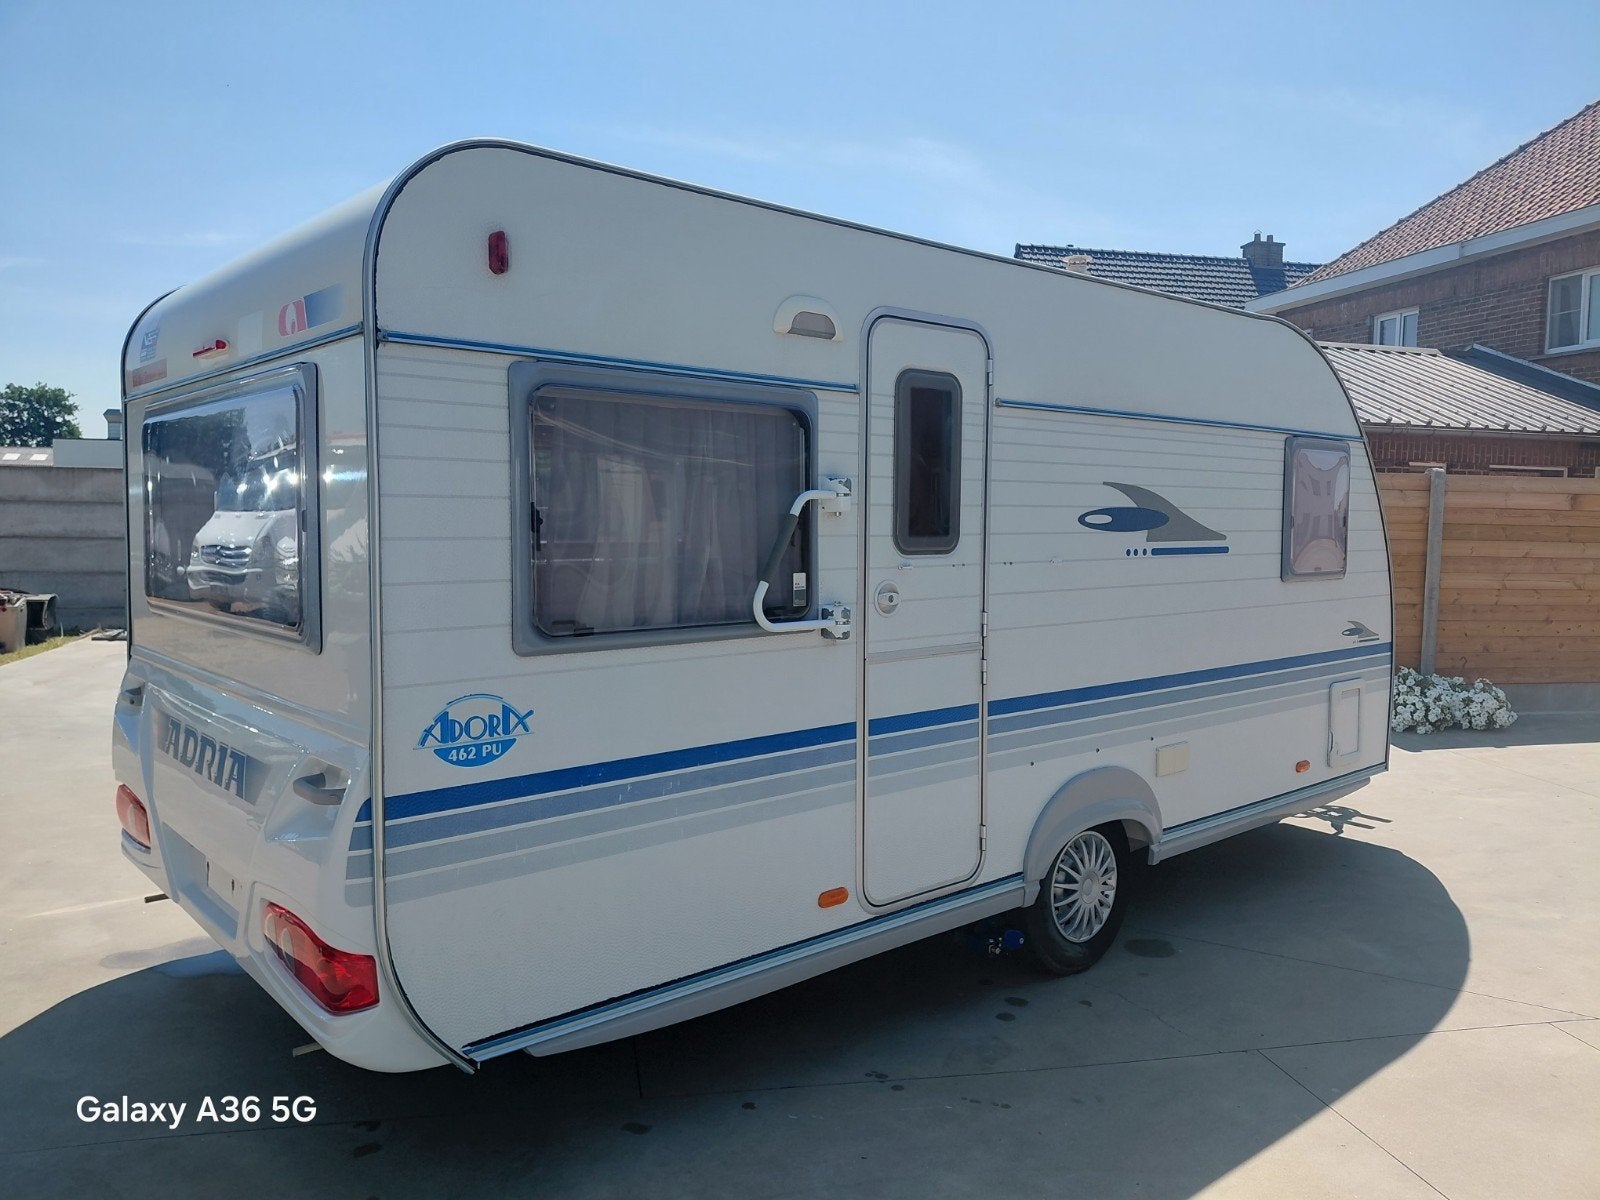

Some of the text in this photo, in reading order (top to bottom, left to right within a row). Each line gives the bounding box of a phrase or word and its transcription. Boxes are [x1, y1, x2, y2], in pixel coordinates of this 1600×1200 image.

[166, 717, 246, 800] ADRIA
[448, 742, 502, 762] 462 PU
